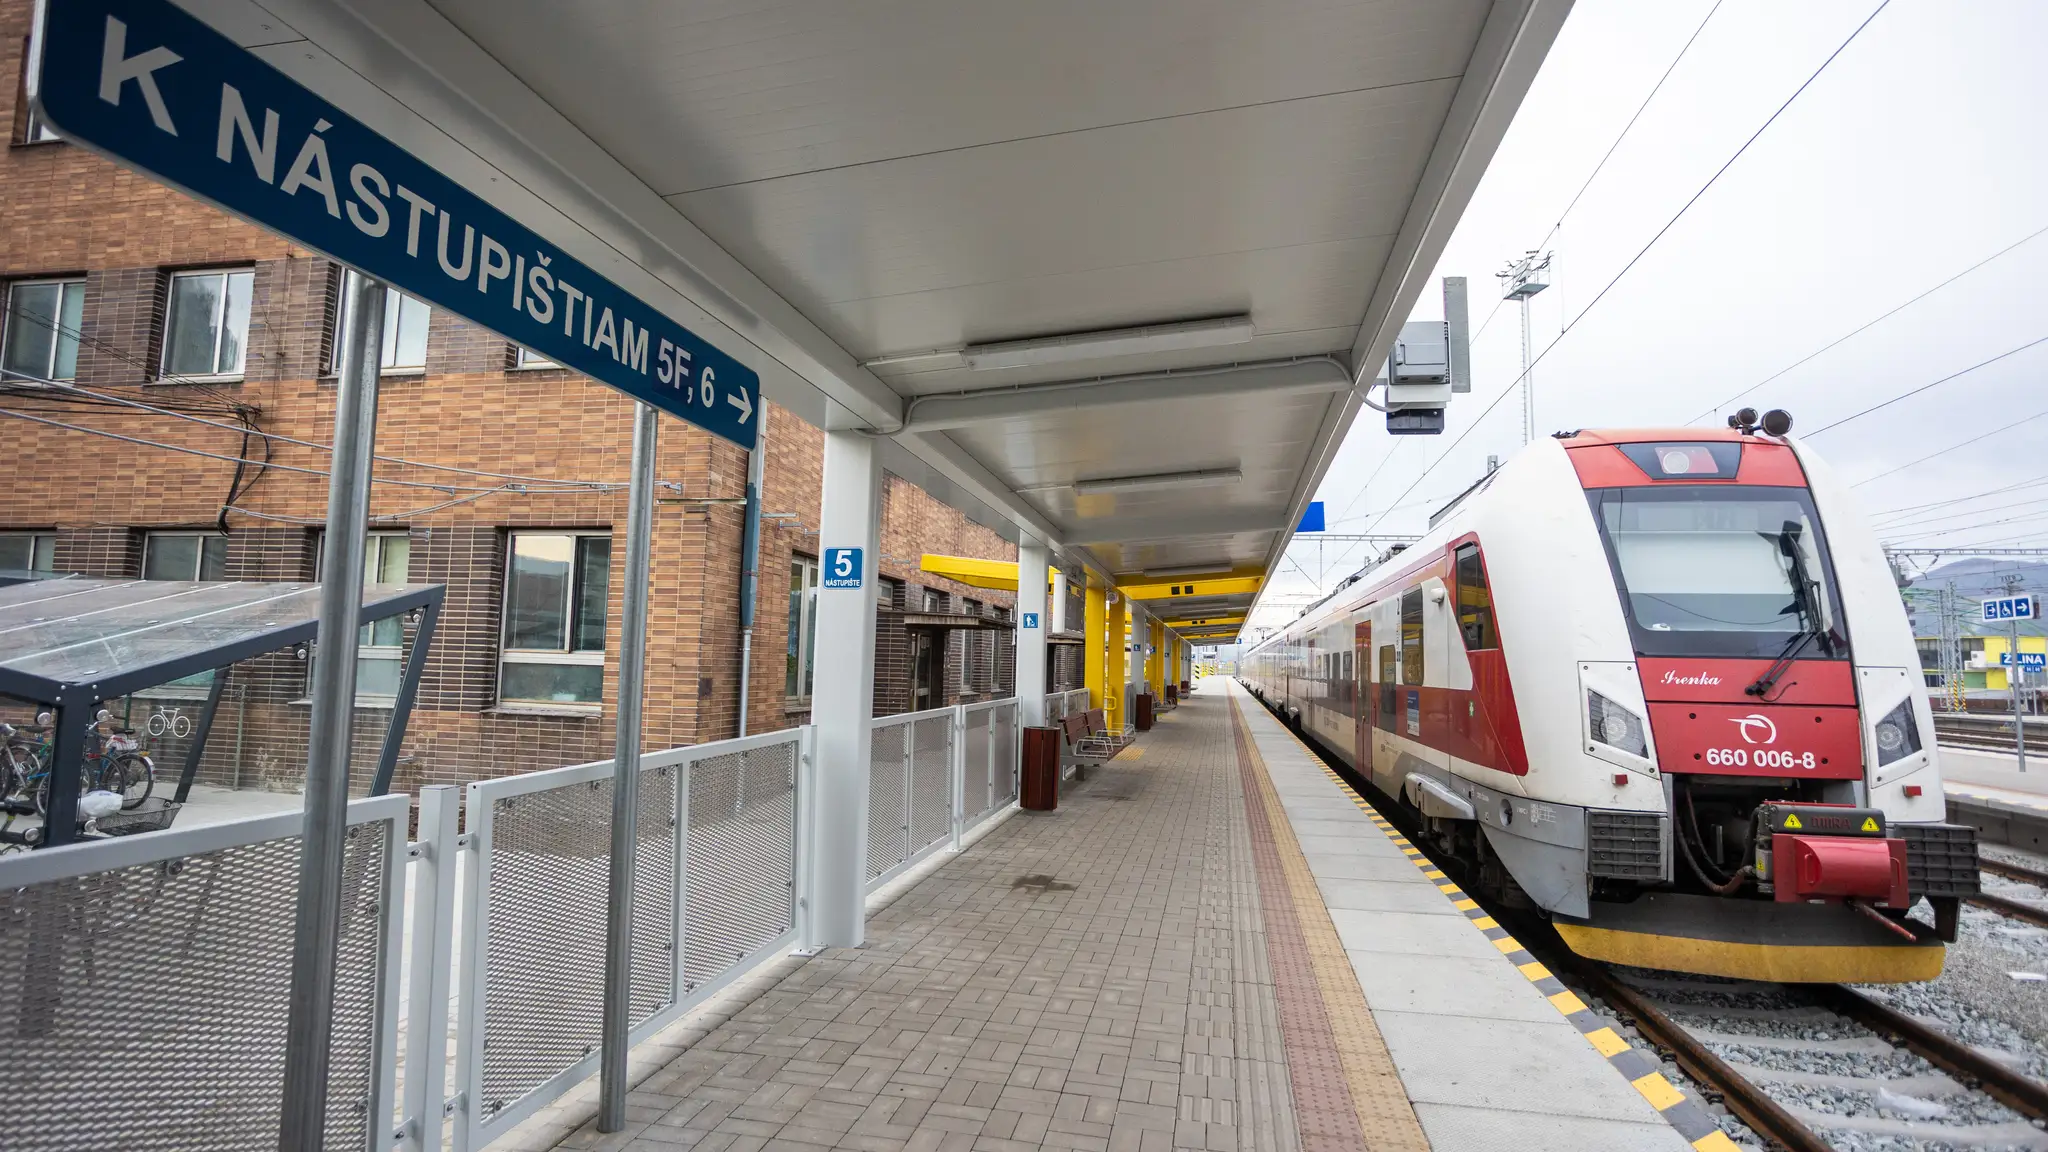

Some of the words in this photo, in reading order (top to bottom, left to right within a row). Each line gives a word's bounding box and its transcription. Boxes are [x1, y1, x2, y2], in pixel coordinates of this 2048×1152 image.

[99, 13, 185, 137] K
[216, 82, 649, 376] NÁSTUPIŠTIAM
[657, 337, 694, 404] 5F,
[701, 366, 715, 408] 6
[834, 549, 853, 577] 5
[825, 577, 861, 587] NÁSTUPIŠTE
[2003, 652, 2043, 665] ŽINA
[1660, 669, 1723, 686] Irenka
[1706, 748, 1748, 766] 660
[1753, 749, 1816, 769] 006-8
